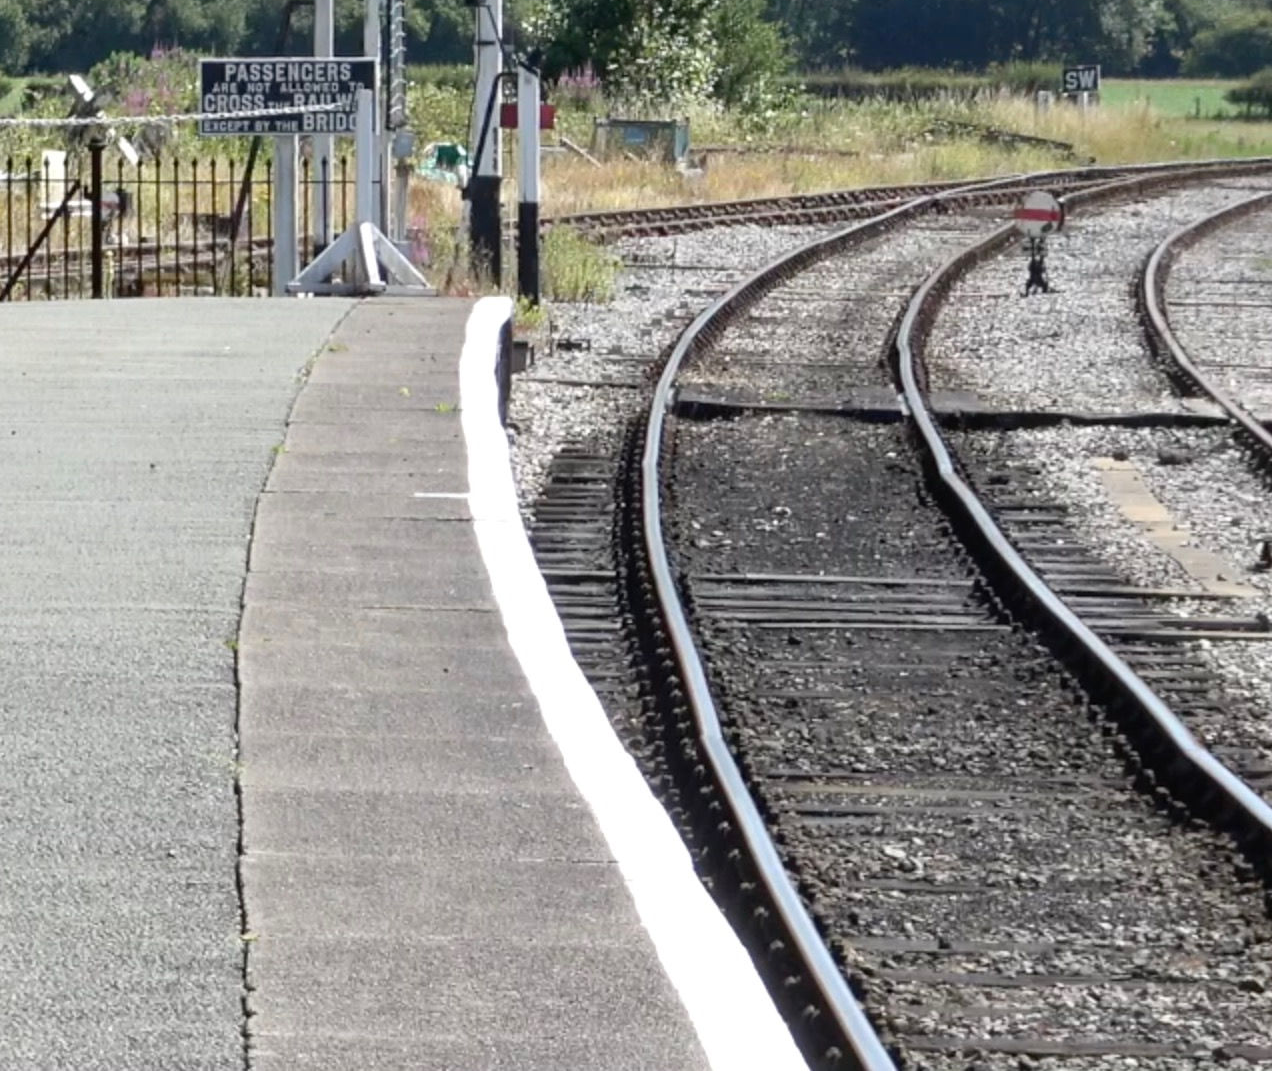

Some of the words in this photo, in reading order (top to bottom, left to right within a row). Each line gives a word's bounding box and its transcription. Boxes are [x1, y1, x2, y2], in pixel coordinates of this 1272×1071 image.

[225, 63, 351, 82] PASSENGERS
[1065, 70, 1095, 89] SW
[212, 82, 237, 93] ARE
[247, 82, 271, 93] NOT
[279, 81, 339, 93] ALLOWED
[203, 93, 265, 113] CROSS
[293, 93, 359, 111] RAILWA
[203, 119, 250, 132] EXCEPT
[254, 120, 270, 132] BY
[274, 119, 298, 132] THE
[303, 113, 358, 131] BRIDG
